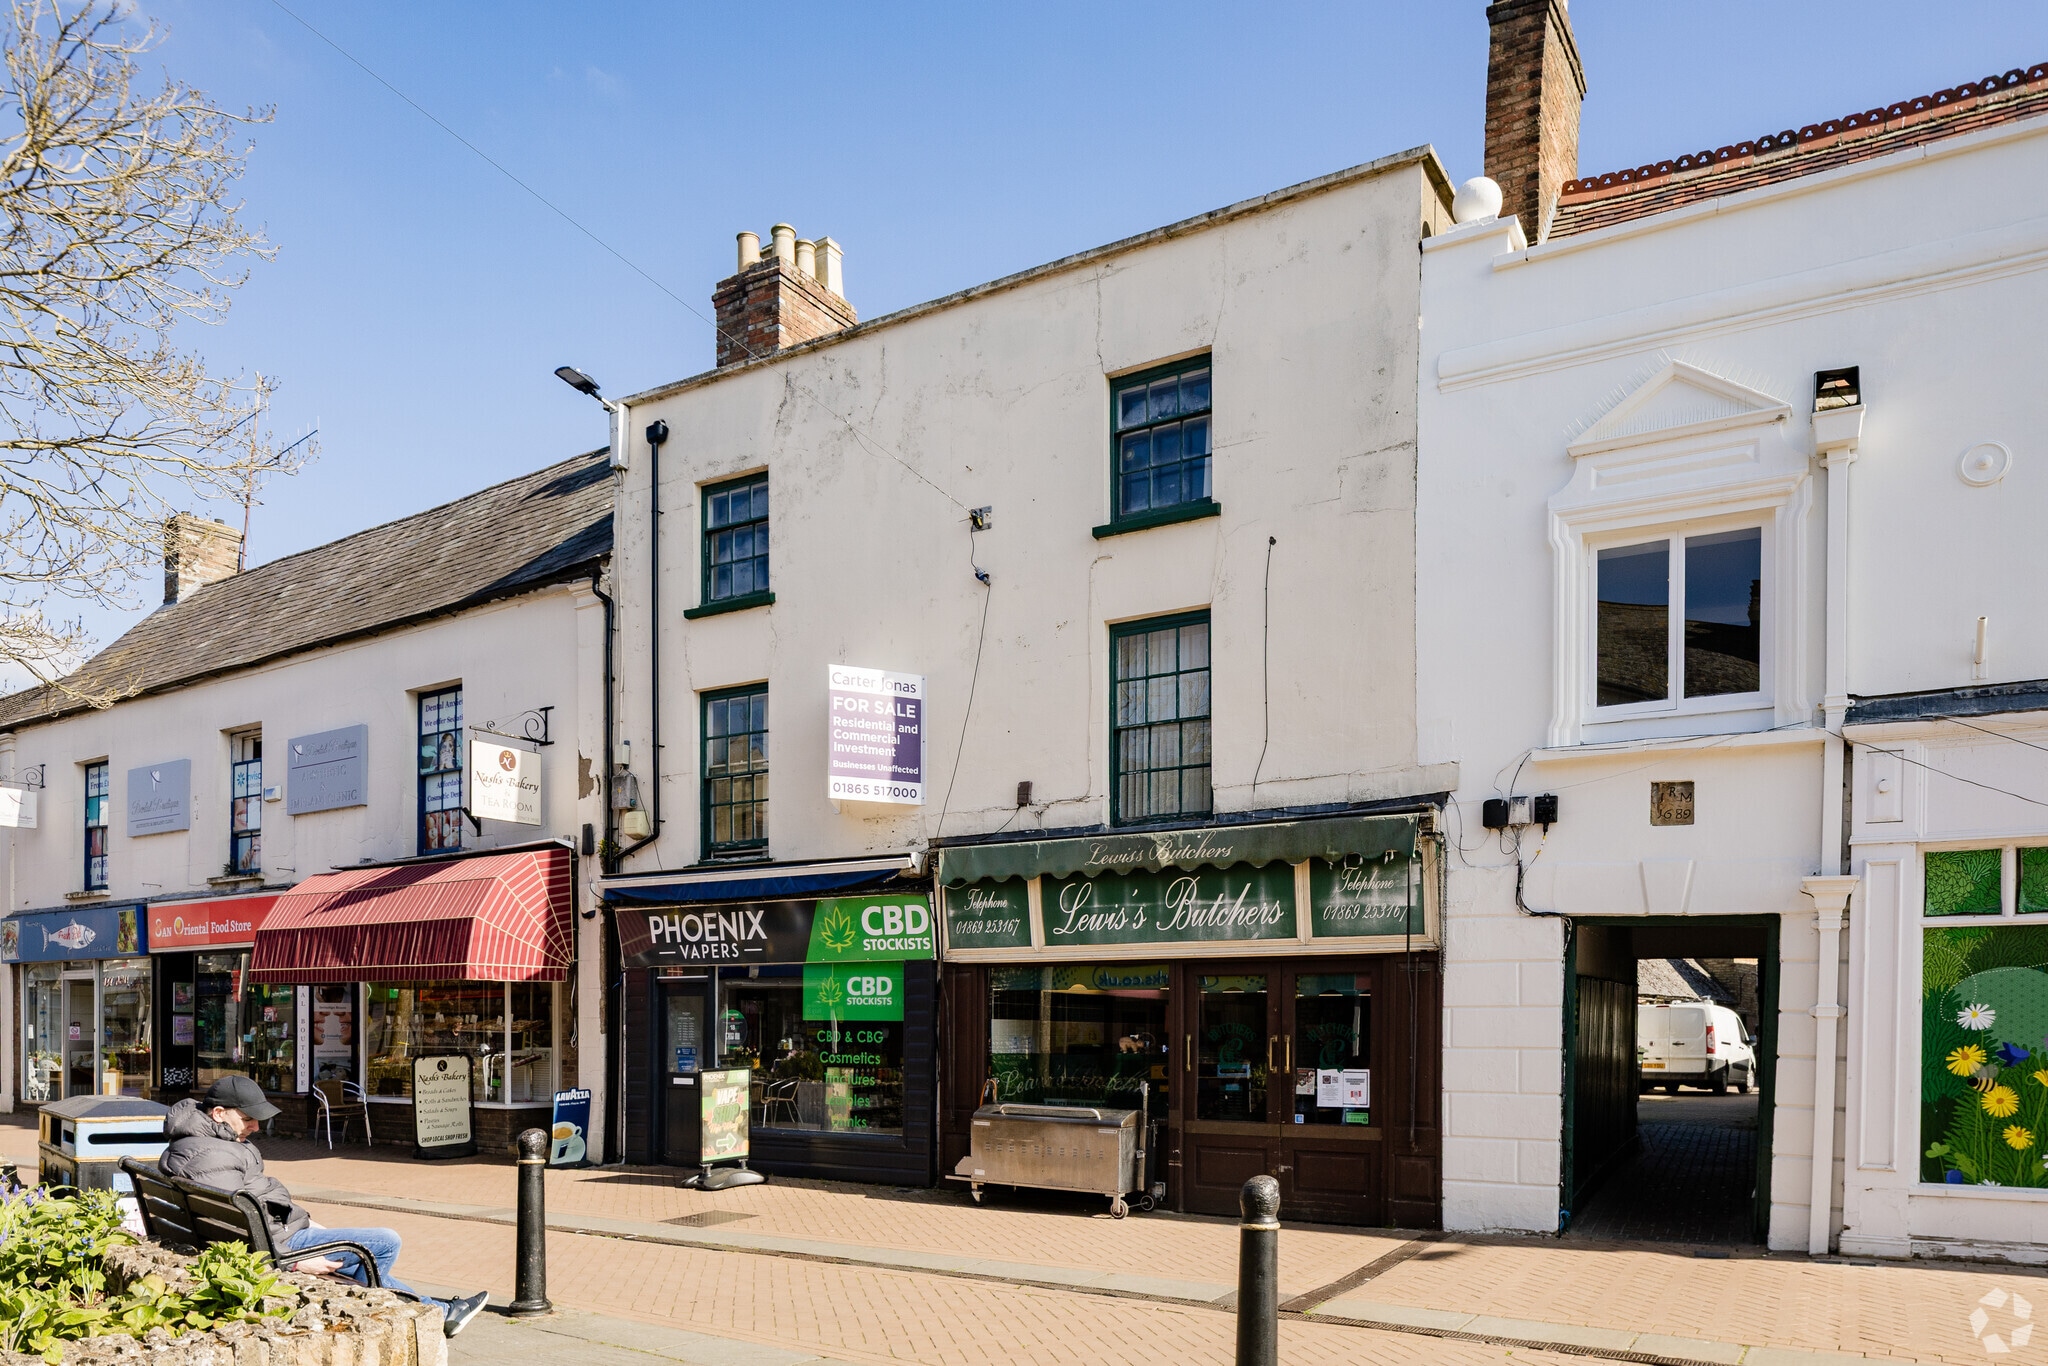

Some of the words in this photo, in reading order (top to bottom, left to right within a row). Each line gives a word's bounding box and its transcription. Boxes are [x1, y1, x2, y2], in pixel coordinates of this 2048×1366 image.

[831, 671, 876, 688] Carter
[880, 677, 917, 693] Jonas
[833, 696, 869, 713] FOR
[874, 701, 916, 719] SALE
[833, 716, 895, 732] Residential
[898, 724, 918, 734] and
[833, 729, 900, 745] Commercial
[833, 742, 896, 757] Investment
[833, 760, 876, 771] Businesses
[877, 764, 919, 775] Unaffected
[474, 771, 503, 788] Nash's
[506, 777, 539, 794] Bakery
[833, 782, 869, 795] 01865
[874, 786, 917, 799] 517000
[503, 798, 533, 812] ROOM
[1084, 842, 1144, 866] Lewis's
[1149, 830, 1234, 861] Butchers
[1336, 866, 1394, 899] Telephone
[963, 888, 1009, 916] Telephone
[1052, 881, 1147, 936] Lewis's
[1156, 876, 1285, 931] Butchers
[861, 904, 929, 936] CBD
[1323, 903, 1361, 921] 01869
[173, 916, 209, 936] Oriental
[210, 919, 230, 934] Food
[230, 920, 252, 932] Store
[648, 910, 768, 943] PHOENIX
[955, 920, 984, 935] 01869
[984, 918, 1021, 937] 253167
[679, 942, 739, 959] VAPERS
[862, 937, 931, 951] STOCKISTS
[846, 976, 893, 996] CBD
[846, 997, 893, 1006] STOCKISTS
[816, 1029, 842, 1043] CBD
[844, 1031, 853, 1043] &
[856, 1030, 884, 1044] CBG
[819, 1051, 881, 1065] Cosmetics
[417, 1071, 441, 1086] Nash's
[441, 1070, 467, 1082] Bakery
[823, 1072, 876, 1086] Tinctures
[556, 1089, 590, 1101] LAVAZZA
[716, 1087, 739, 1105] VAPE
